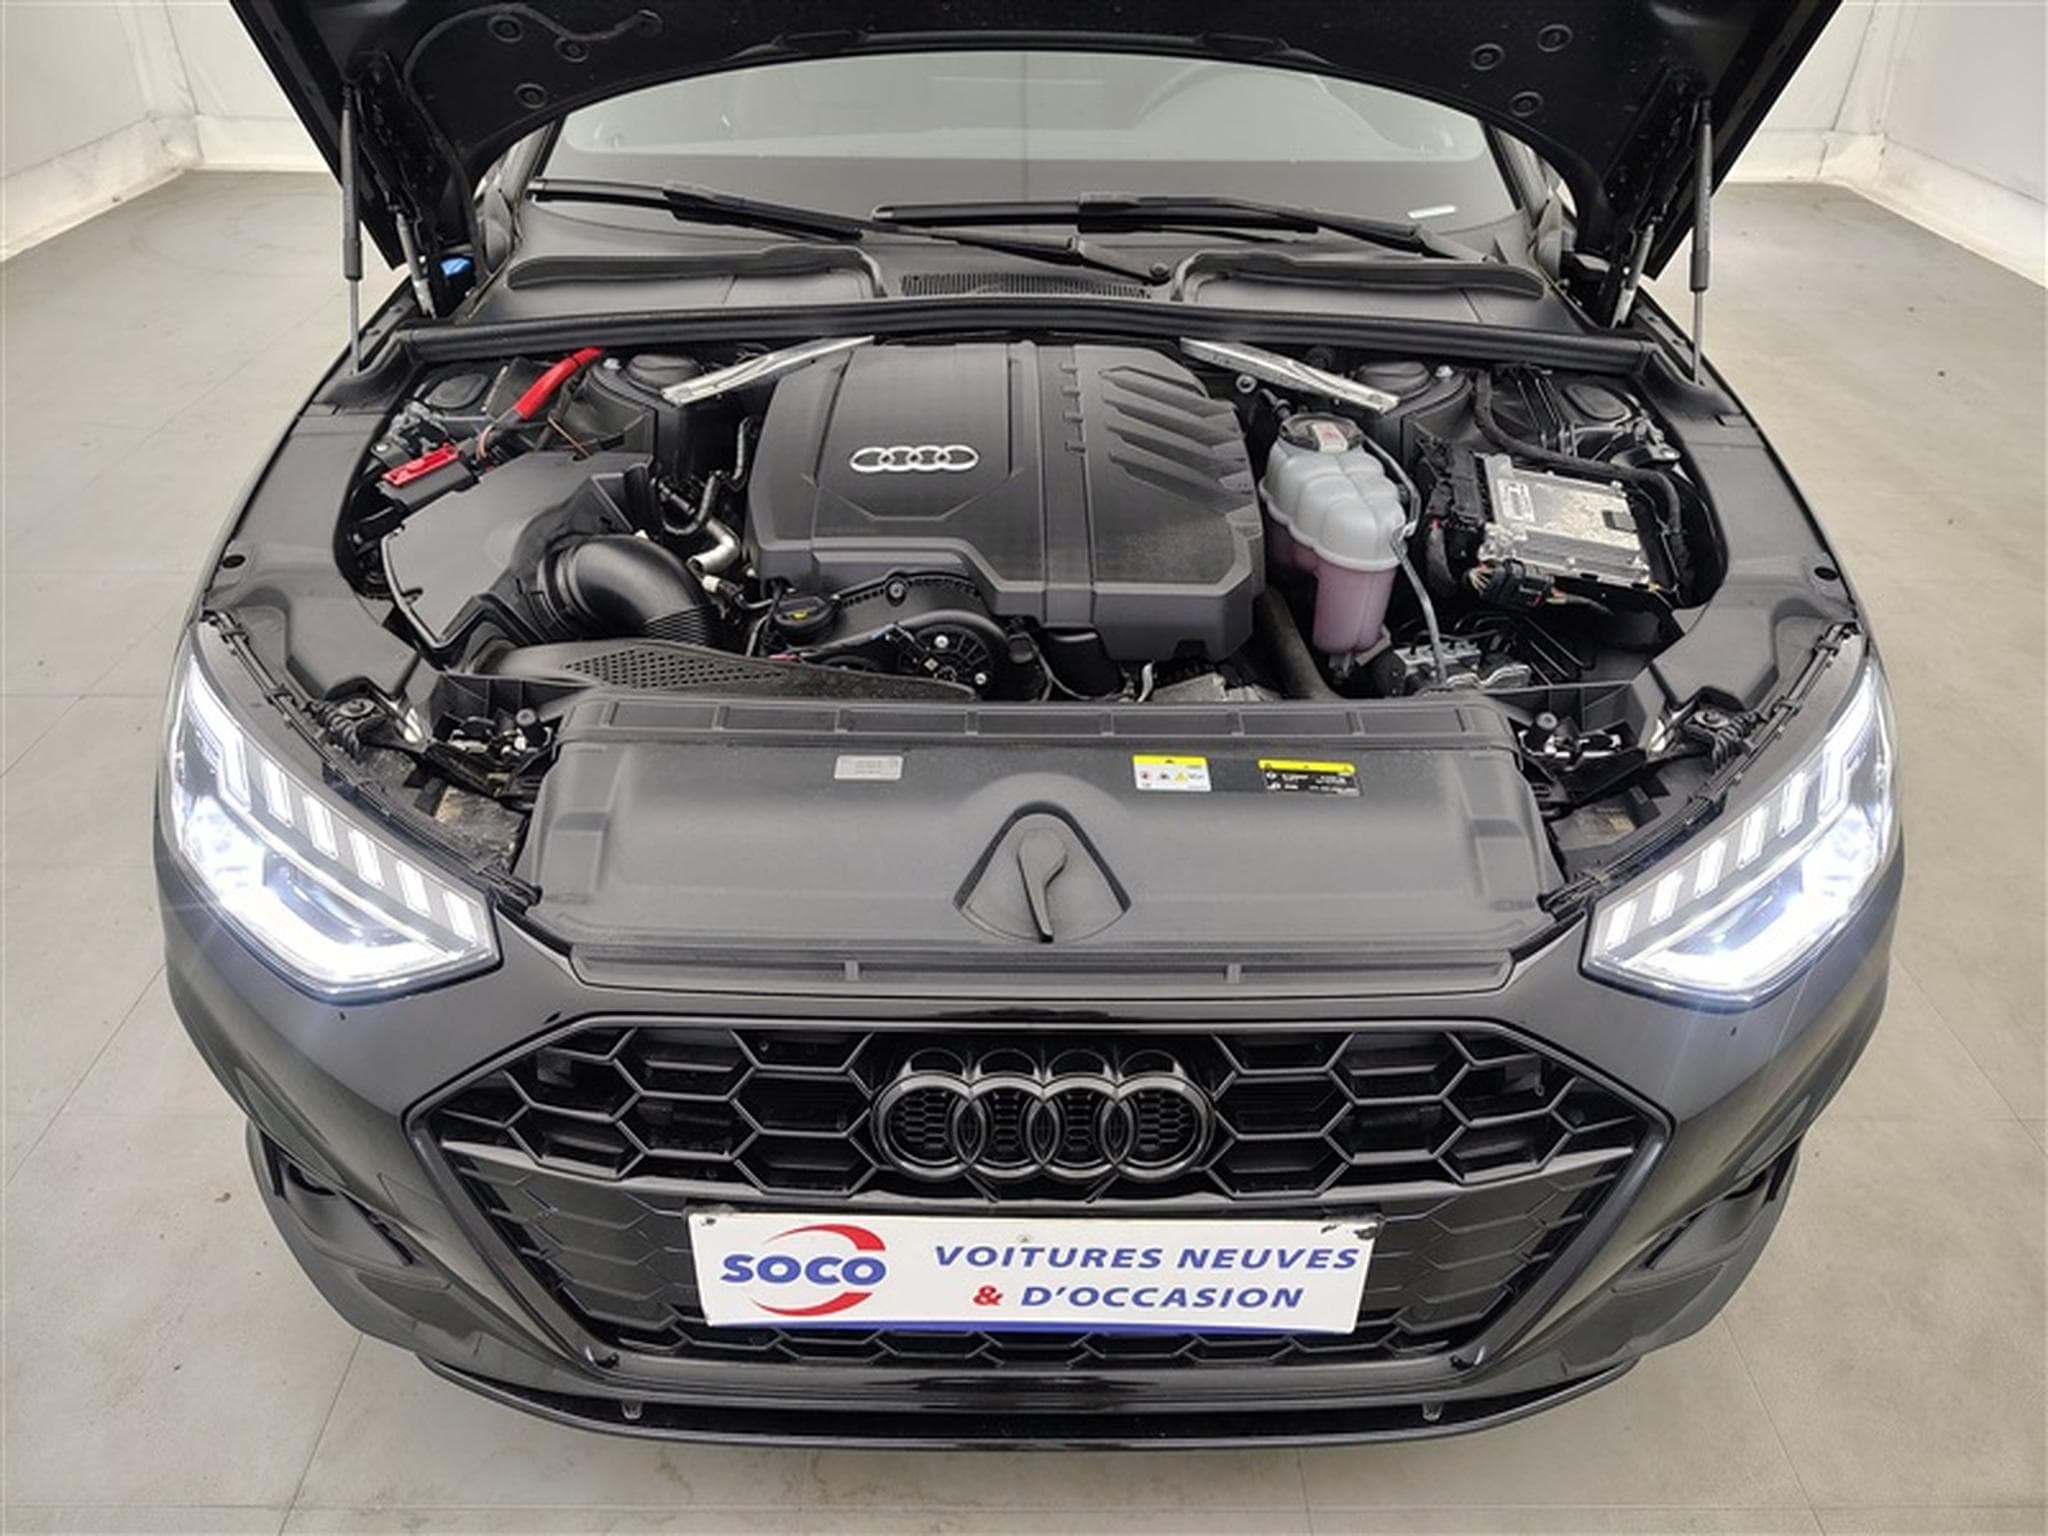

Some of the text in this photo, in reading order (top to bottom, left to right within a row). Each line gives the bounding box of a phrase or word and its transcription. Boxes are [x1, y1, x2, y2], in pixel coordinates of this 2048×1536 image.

[721, 1253, 886, 1285] SOCO
[935, 1245, 1358, 1270] VOITURES NEUVES
[972, 1285, 1304, 1308] & D'OCCASION
